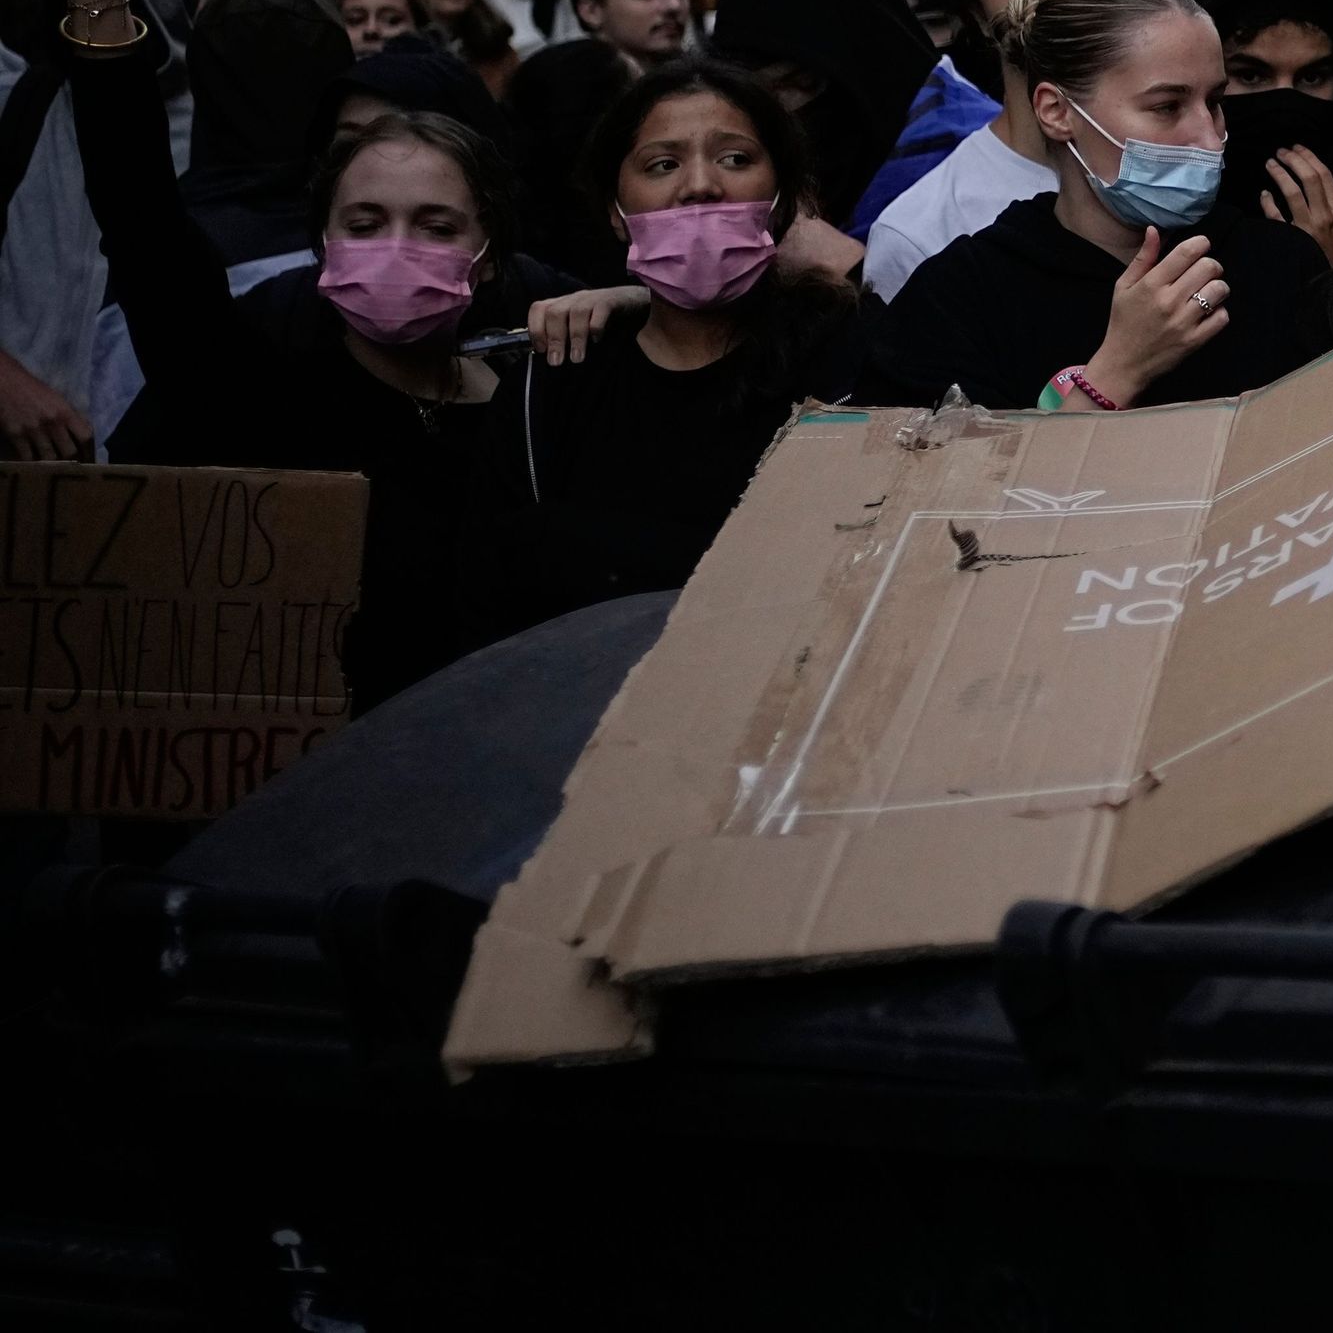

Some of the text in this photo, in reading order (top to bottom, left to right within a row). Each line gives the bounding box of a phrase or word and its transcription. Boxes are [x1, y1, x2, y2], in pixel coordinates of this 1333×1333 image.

[0, 472, 279, 590] LEZ VOS
[1063, 598, 1185, 632] OF
